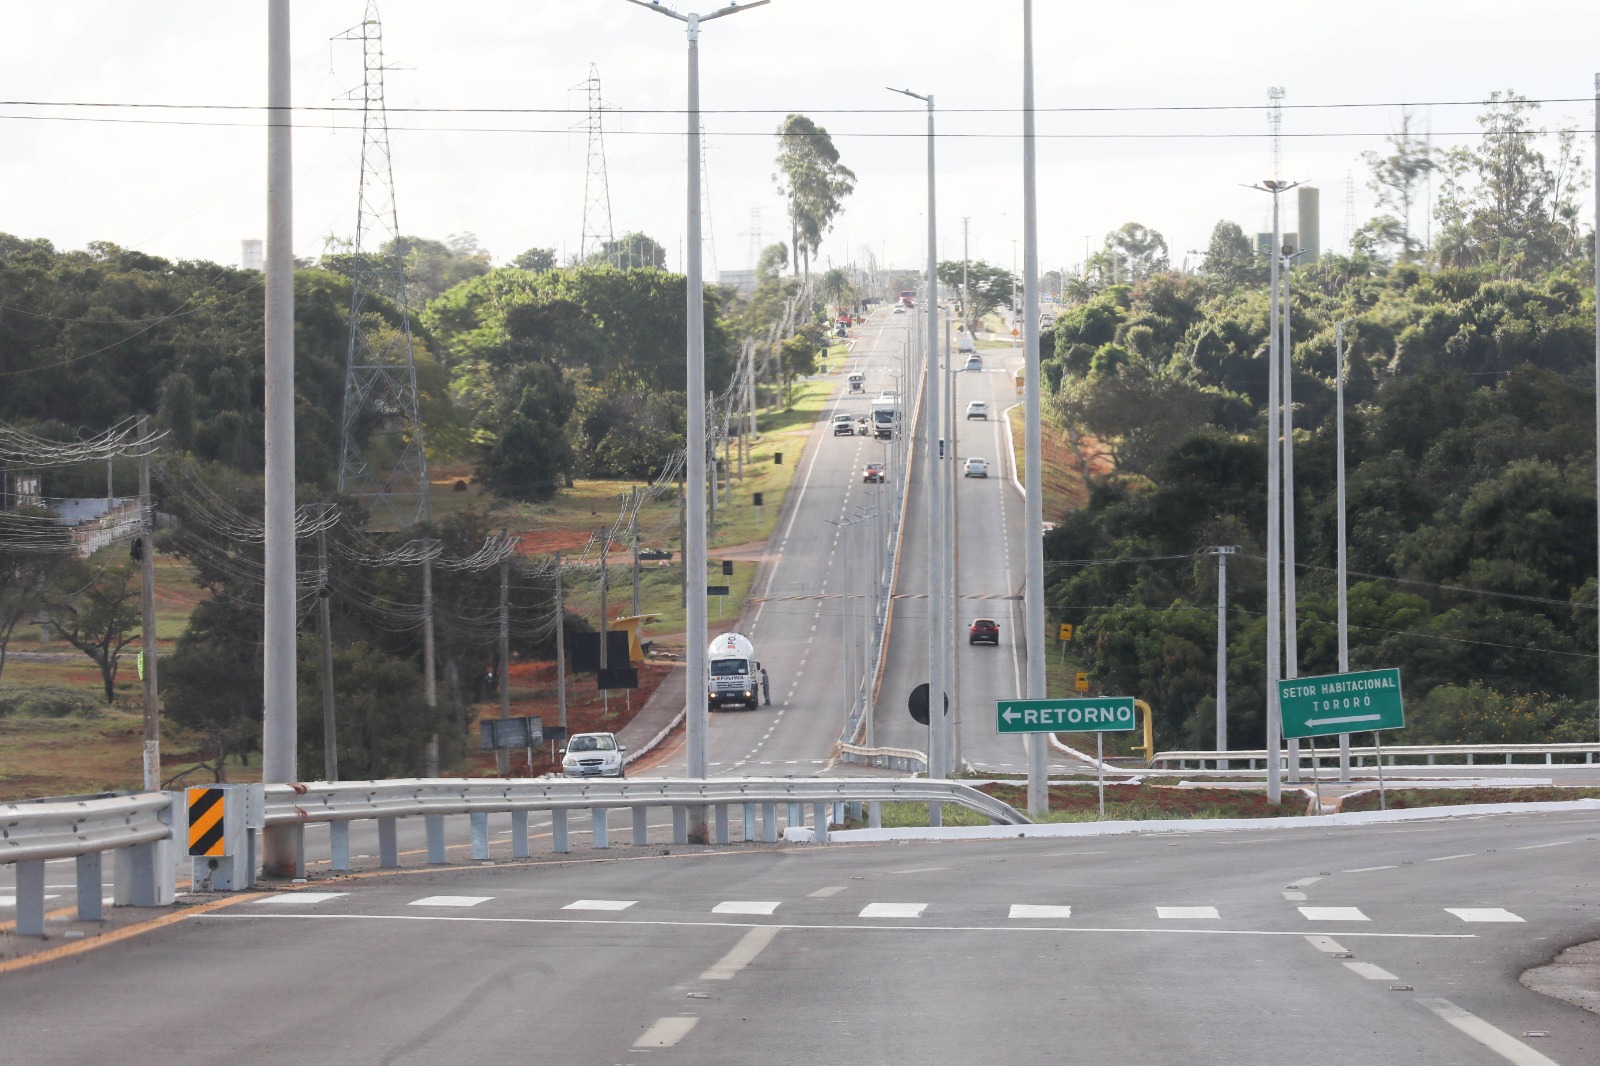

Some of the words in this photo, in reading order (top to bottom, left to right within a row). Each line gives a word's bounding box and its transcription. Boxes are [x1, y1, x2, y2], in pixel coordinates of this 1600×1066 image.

[1283, 685, 1316, 699] SETOR
[1321, 677, 1396, 695] HABITACIONAL
[1313, 693, 1371, 711] TORORÓ
[1024, 706, 1131, 724] RETORNO
